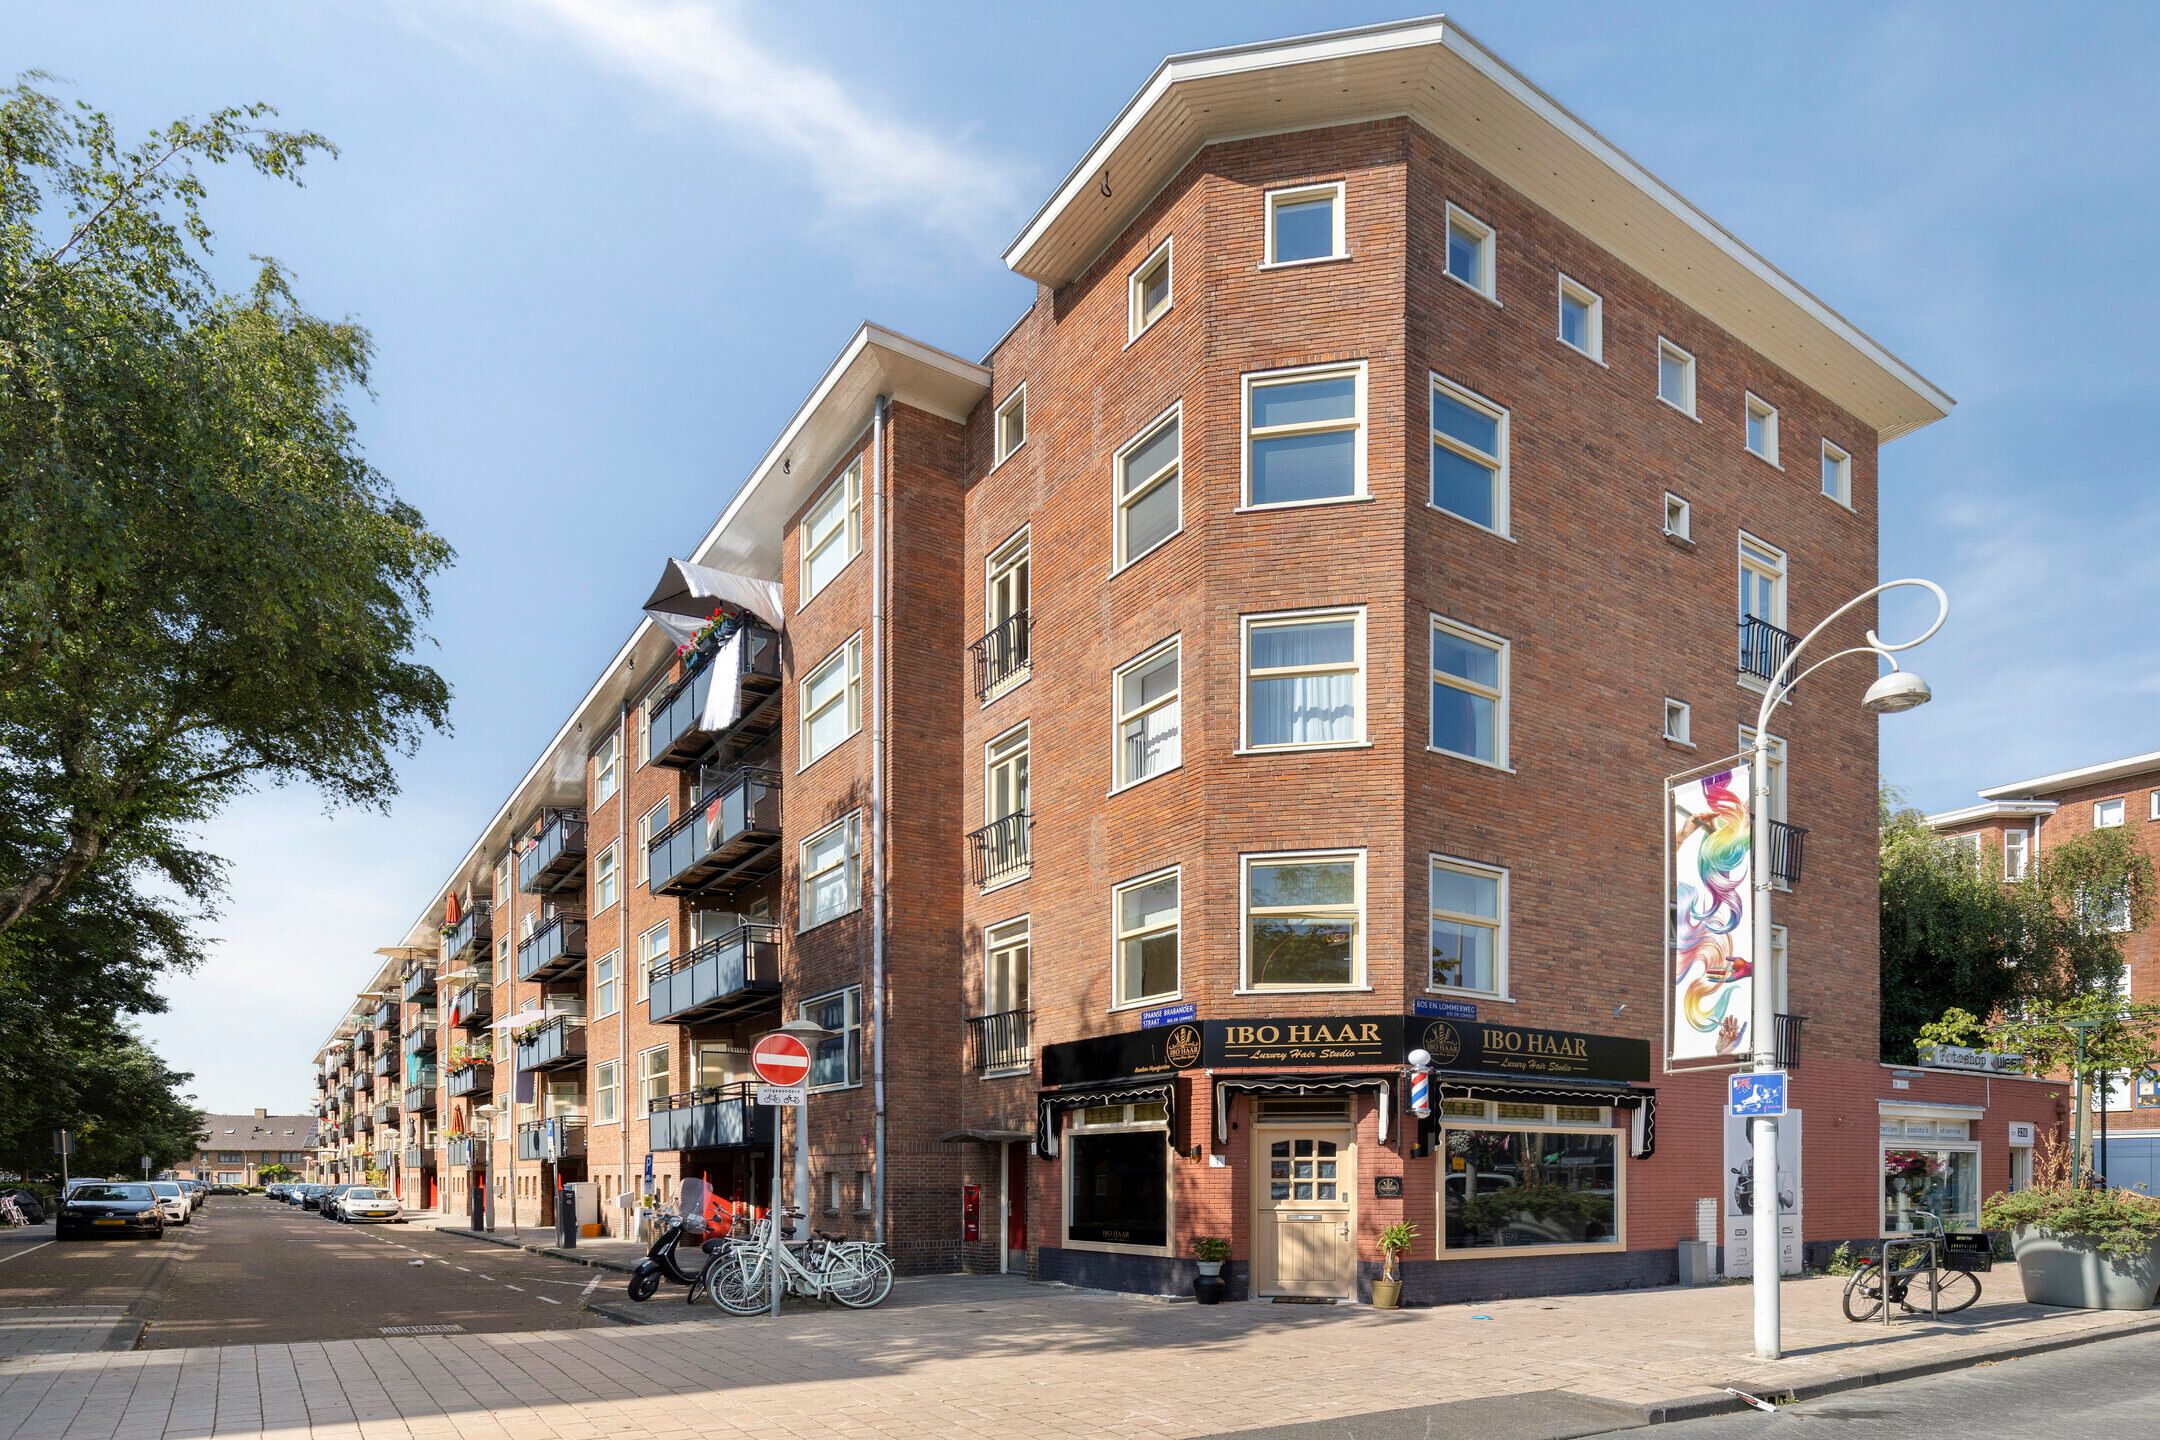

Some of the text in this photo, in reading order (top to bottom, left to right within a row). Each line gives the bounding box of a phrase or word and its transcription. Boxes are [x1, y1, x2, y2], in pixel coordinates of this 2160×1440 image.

[1142, 1004, 1194, 1020] SPAANSE BRABANDER
[1416, 1000, 1475, 1014] BOS EN LOMMERWEG
[1142, 1019, 1160, 1028] STRAAT
[1225, 1023, 1382, 1044] IBO HAAR
[1439, 1044, 1458, 1052] HAAR
[1482, 1029, 1588, 1057] IBO HAAR
[1170, 1047, 1198, 1056] IBO HAAR
[1250, 1048, 1355, 1061] Luxury Hair Studio
[1500, 1057, 1572, 1072] Luxury Hair Studio
[646, 1157, 651, 1172] P
